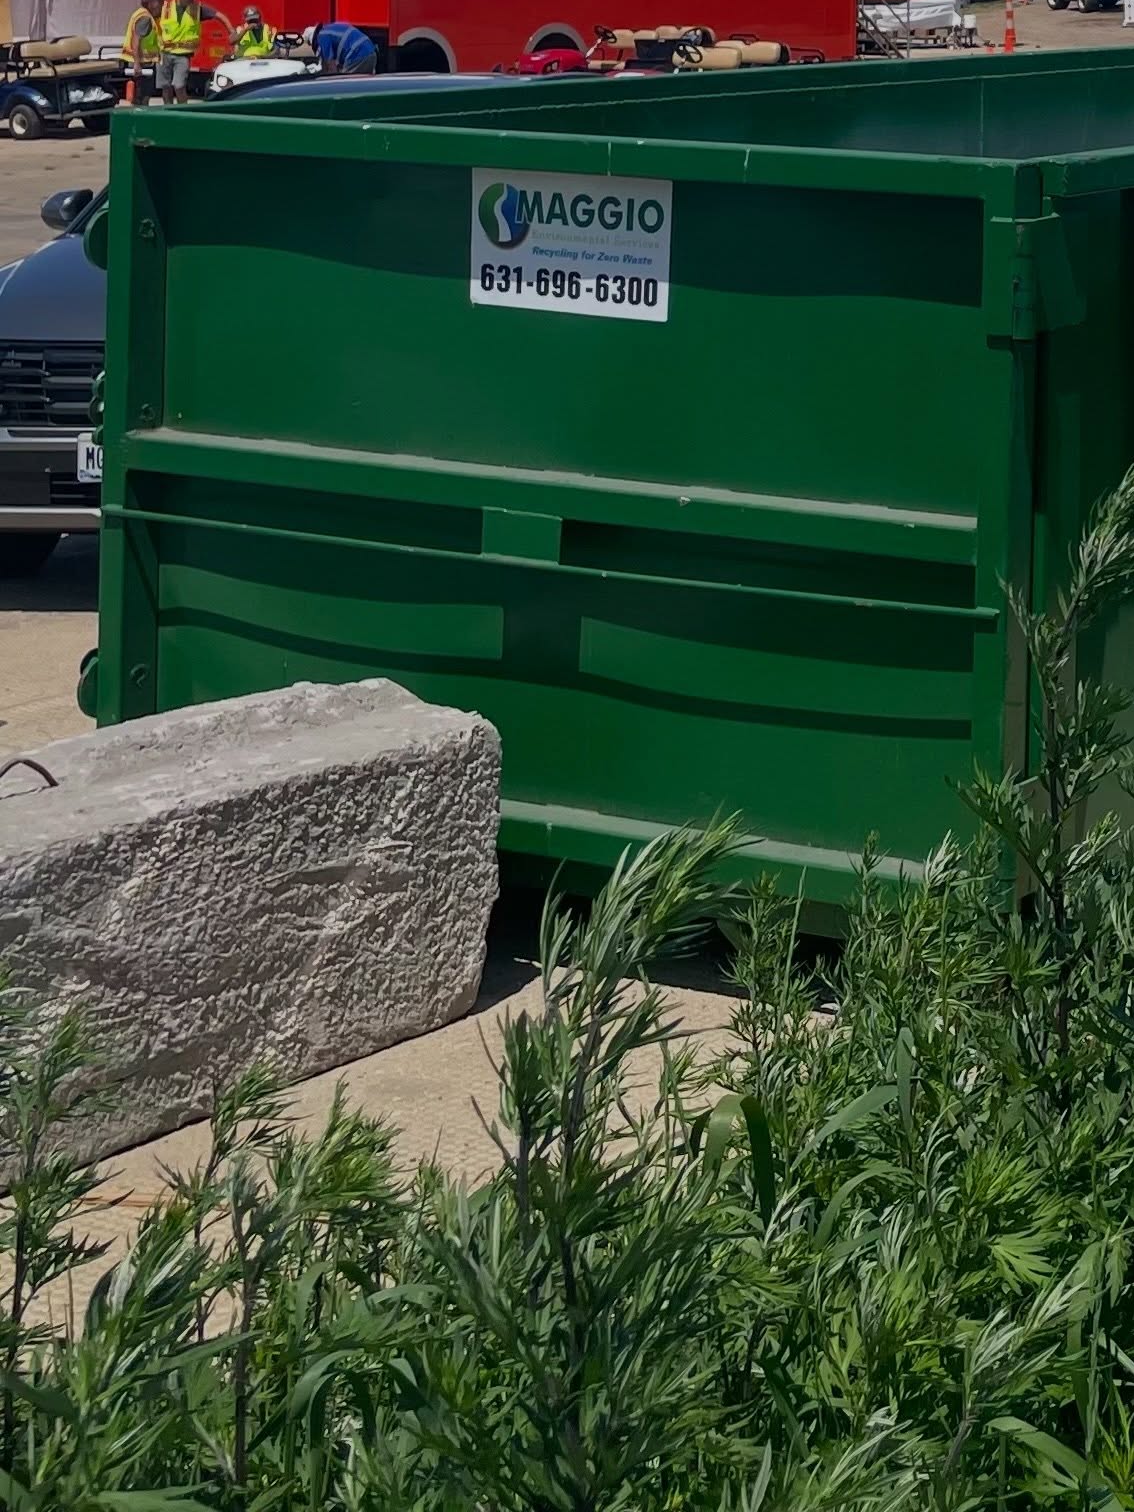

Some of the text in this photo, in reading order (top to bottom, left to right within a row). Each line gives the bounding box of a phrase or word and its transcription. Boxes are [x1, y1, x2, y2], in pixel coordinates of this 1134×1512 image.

[516, 189, 665, 234] MAGGIO
[532, 246, 653, 266] Recycling for Zero Waste
[480, 263, 659, 308] 631-696-6300
